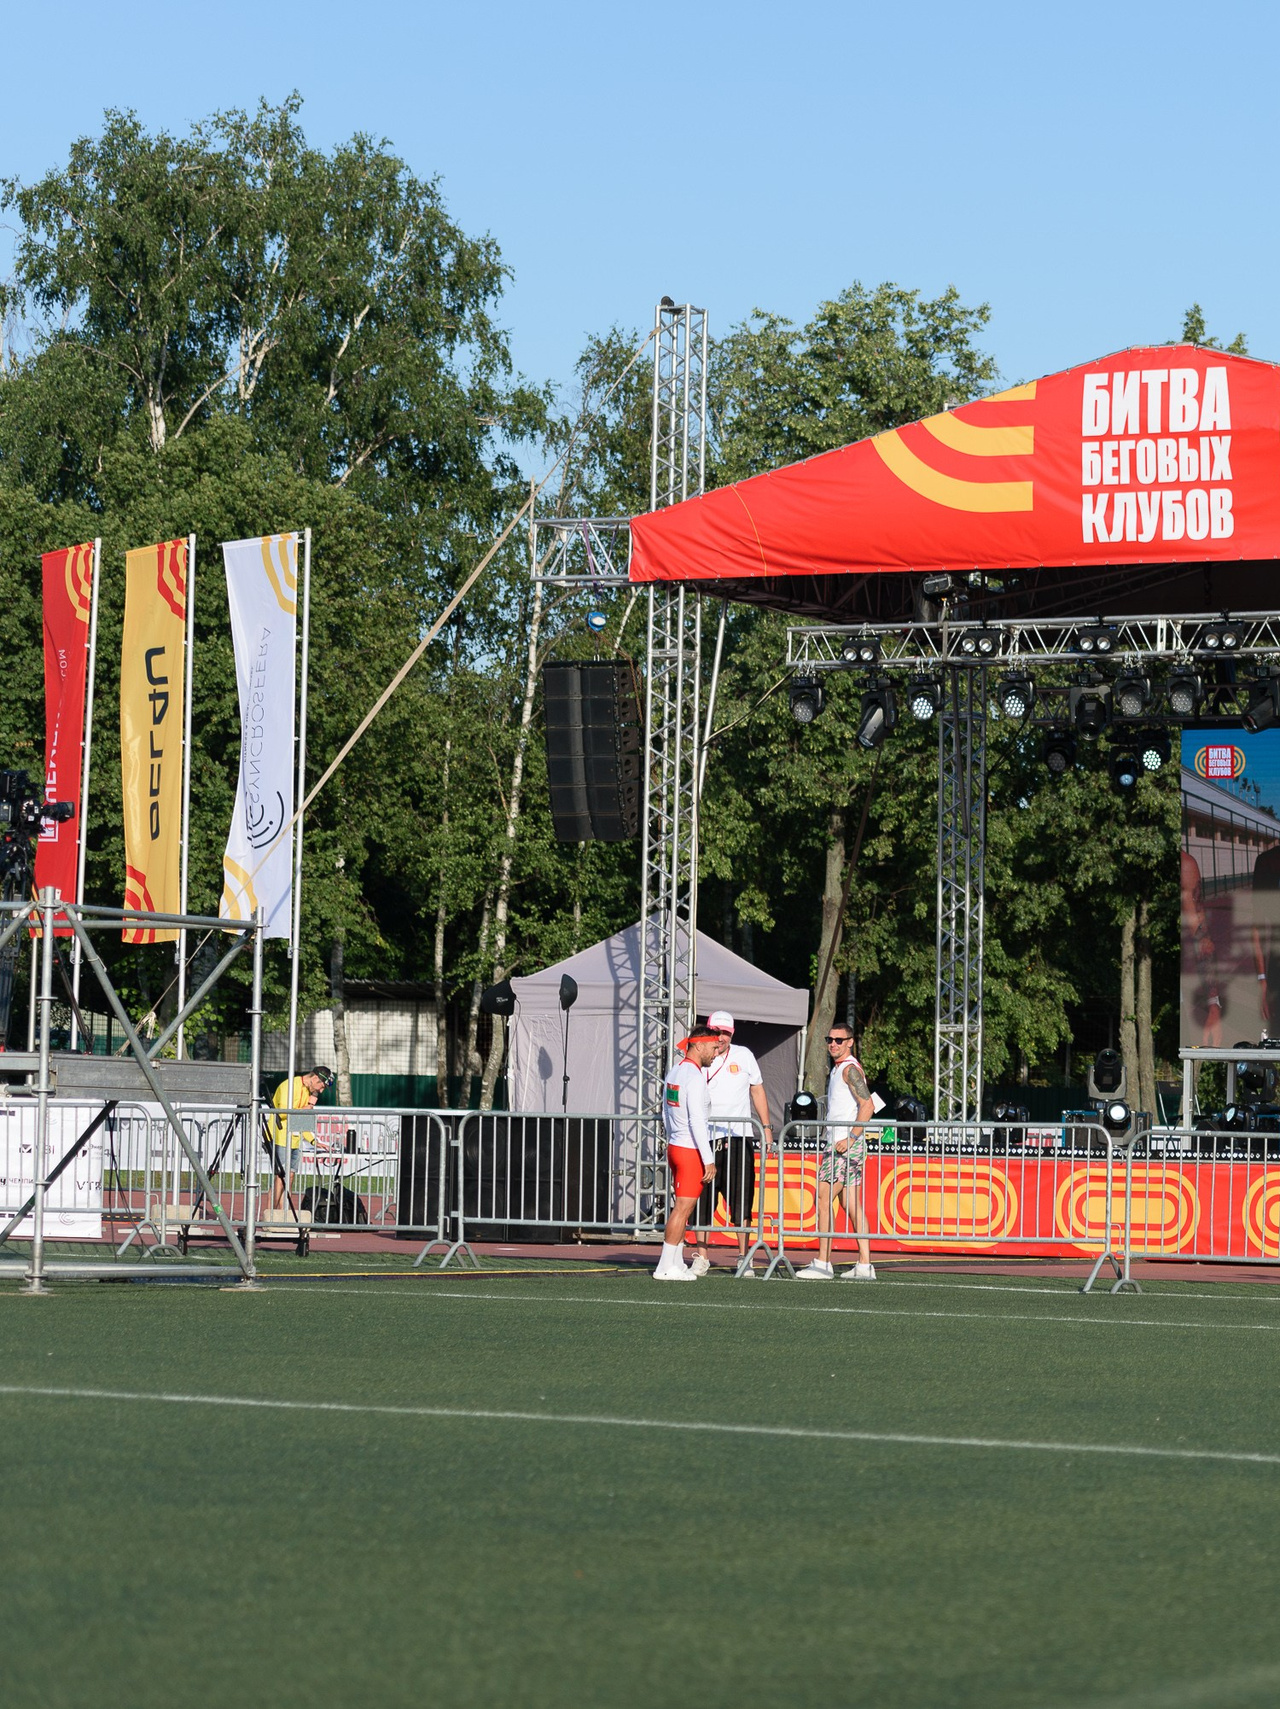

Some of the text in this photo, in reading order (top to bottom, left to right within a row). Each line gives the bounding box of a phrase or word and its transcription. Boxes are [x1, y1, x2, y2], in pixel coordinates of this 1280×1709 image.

[1082, 366, 1231, 437] БИТВА
[1082, 435, 1233, 486] БЕГОВЫХ
[1082, 488, 1235, 544] КЛУБОВ
[1208, 748, 1231, 759] БИТВА
[1208, 759, 1231, 767] БЕГОВЫХ
[1208, 767, 1232, 777] КЛУБОВ
